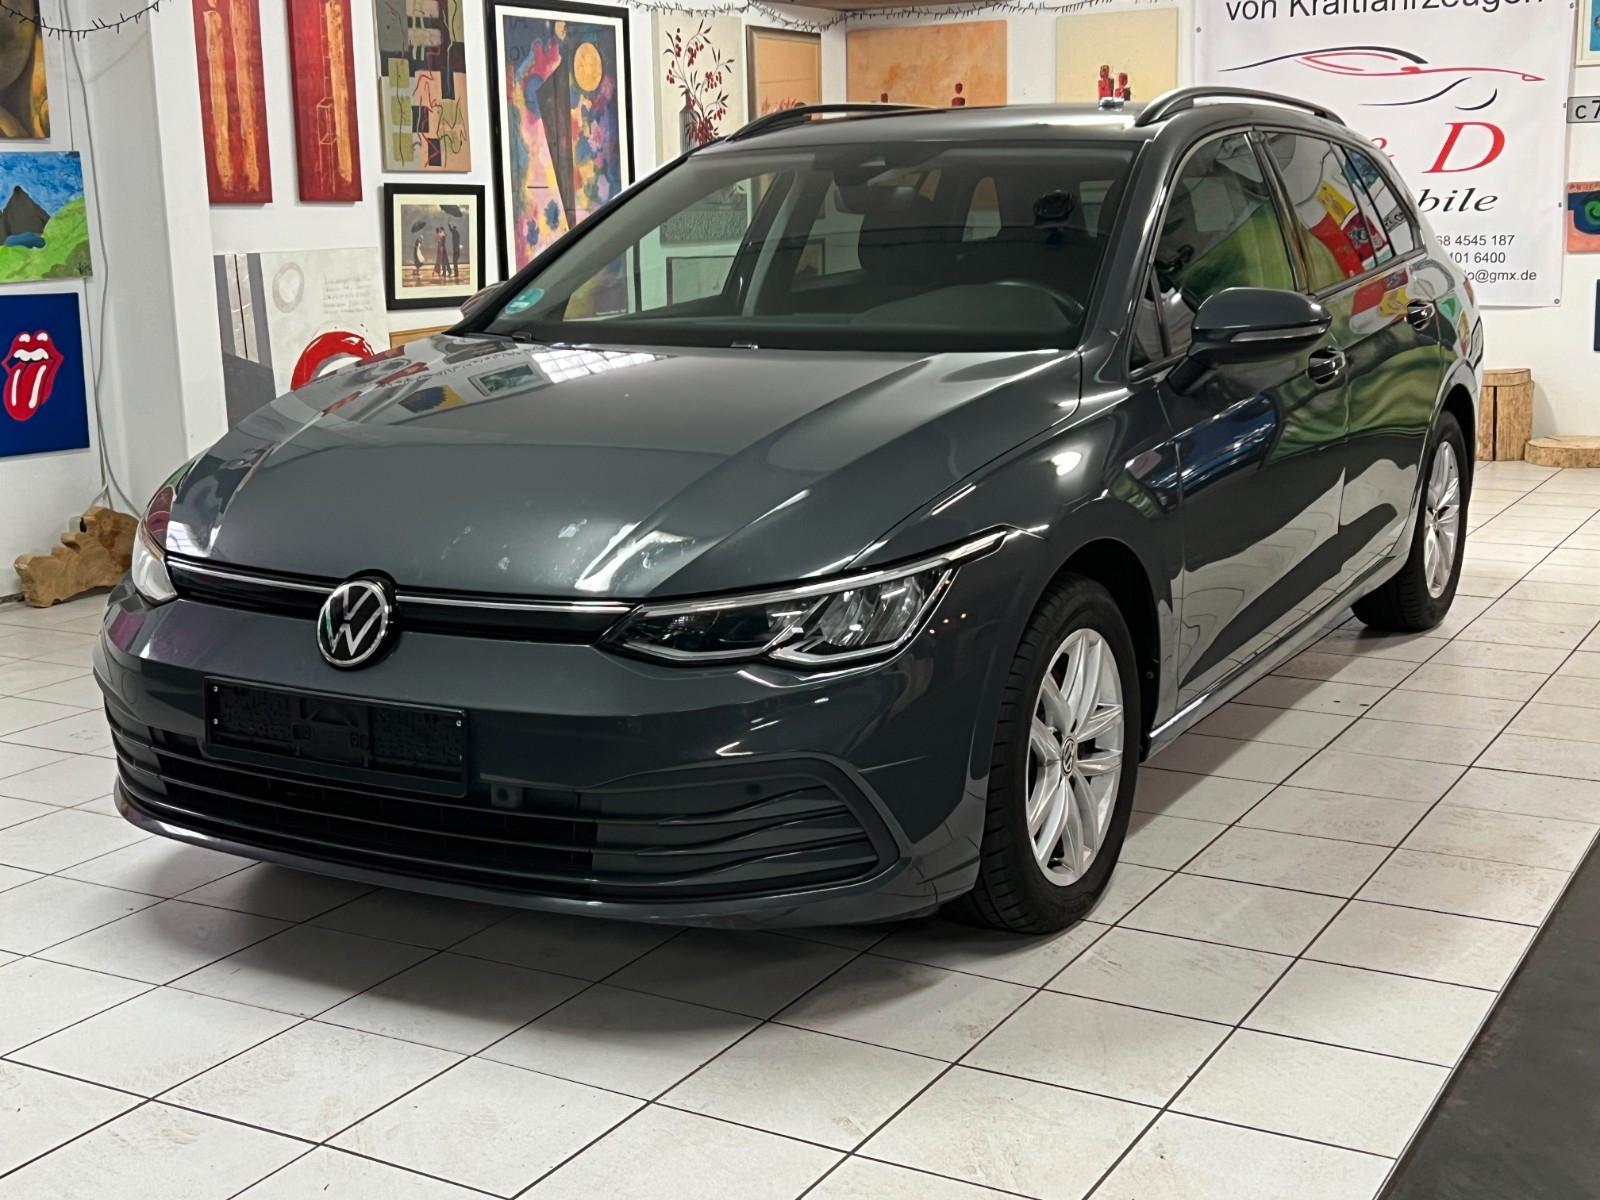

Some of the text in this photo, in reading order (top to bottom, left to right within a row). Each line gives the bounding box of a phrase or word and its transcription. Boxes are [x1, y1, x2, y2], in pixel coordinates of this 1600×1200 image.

[1226, 0, 1277, 21] von
[1420, 121, 1506, 174] D
[1417, 187, 1499, 213] bile
[1436, 234, 1515, 246] 68 4545 187
[1474, 252, 1506, 263] 6400
[1467, 269, 1537, 283] o@gmx.de
